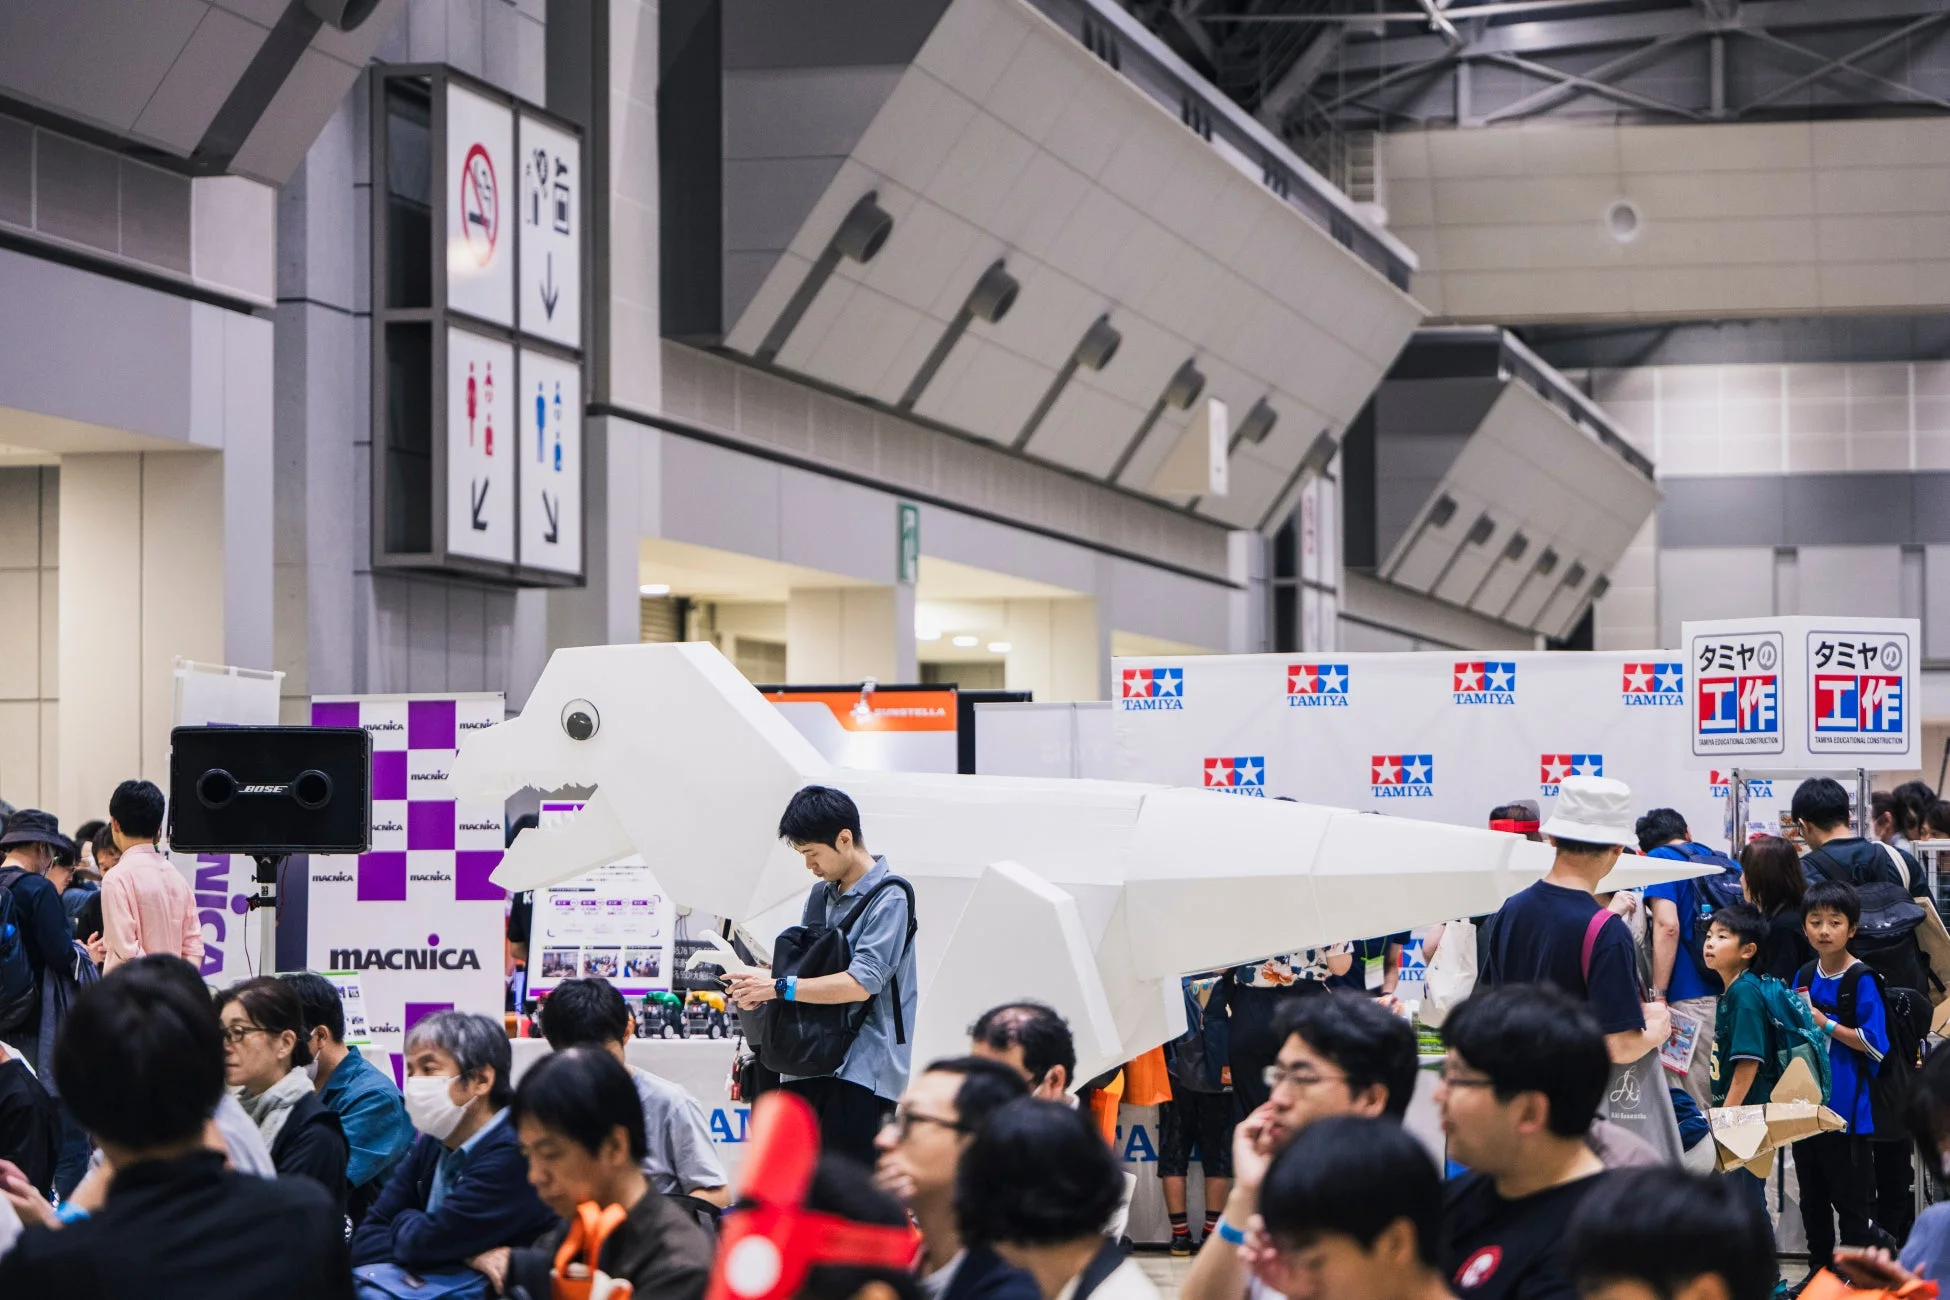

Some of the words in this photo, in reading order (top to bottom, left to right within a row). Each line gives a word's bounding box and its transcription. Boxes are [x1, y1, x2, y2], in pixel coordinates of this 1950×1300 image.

[1699, 640, 1777, 672] タミヤの
[1815, 640, 1903, 671] タミヤの
[1122, 698, 1184, 711] TAMIYA
[1287, 695, 1349, 707] TAMIYA
[1453, 693, 1515, 705] TAMIYA
[1622, 694, 1684, 706] TAMIYA
[1700, 679, 1776, 731] 工作
[1817, 678, 1901, 731] 工作
[1834, 736, 1866, 744] EDUCATIONAL
[1371, 785, 1434, 798] TAMIYA
